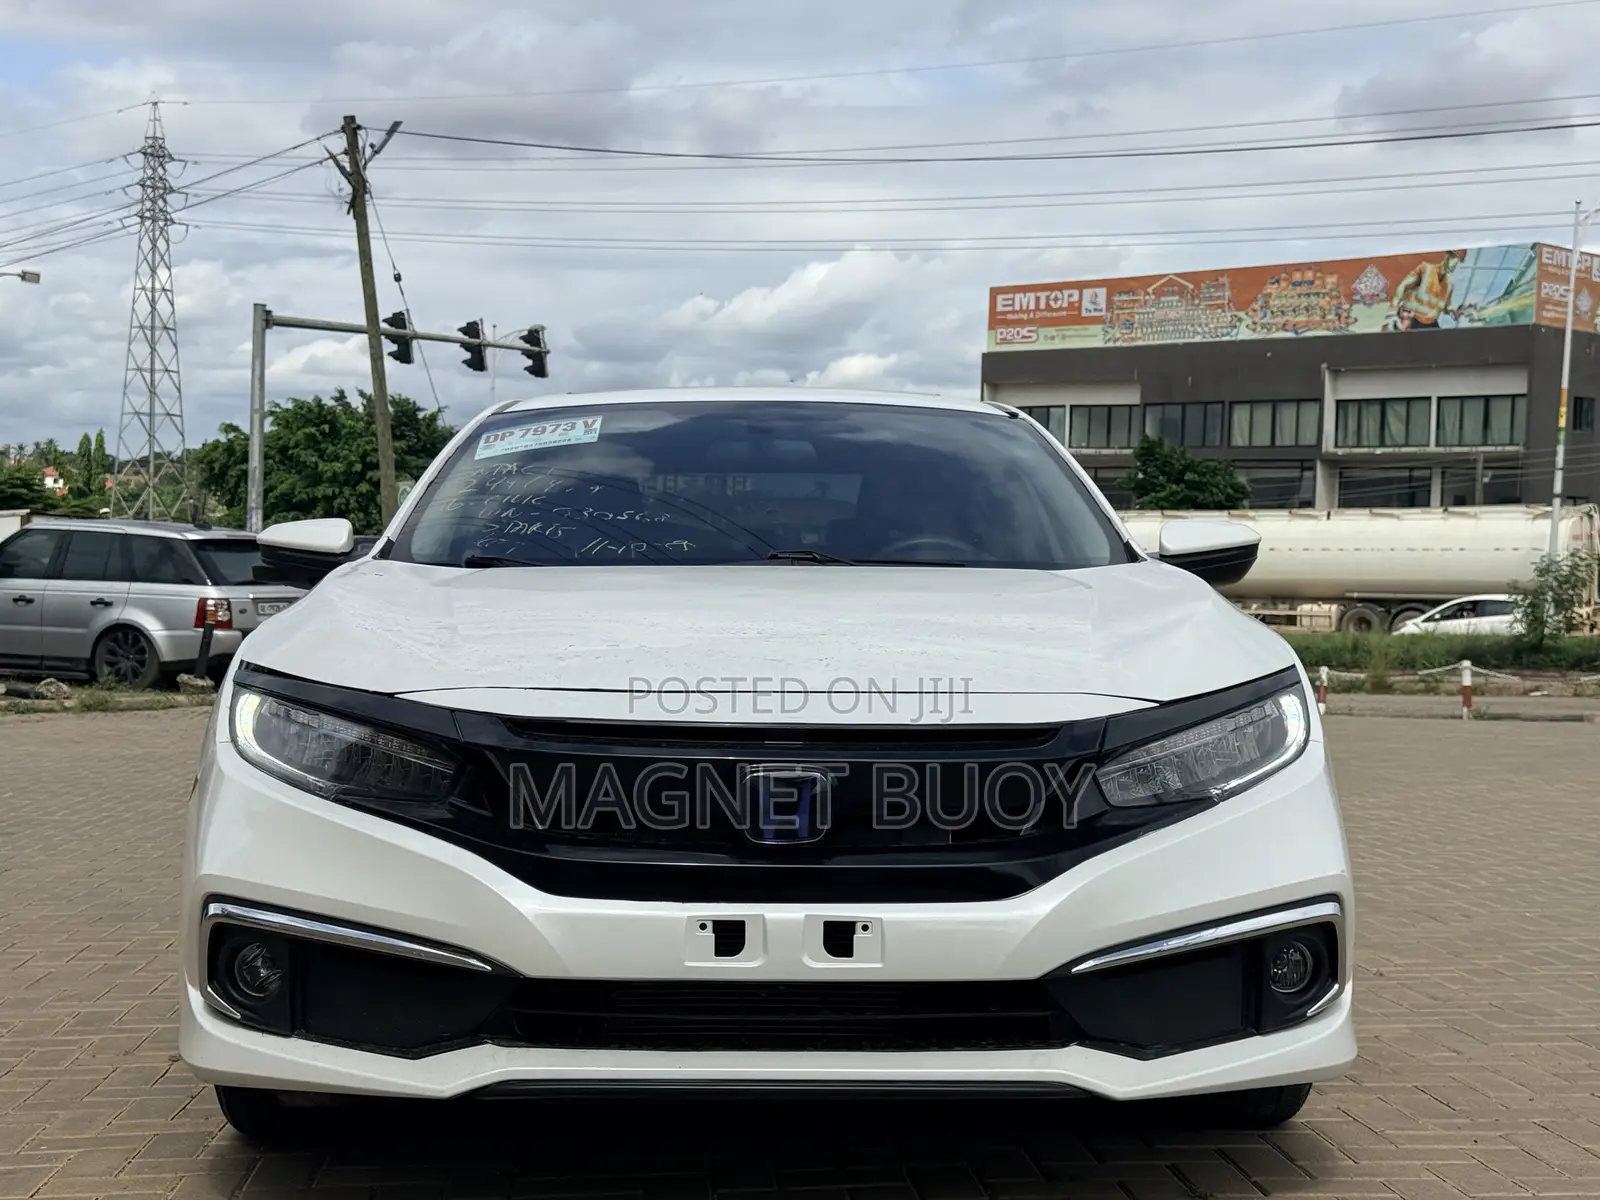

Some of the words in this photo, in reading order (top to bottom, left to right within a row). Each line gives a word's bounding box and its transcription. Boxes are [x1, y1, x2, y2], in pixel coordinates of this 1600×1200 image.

[996, 289, 1079, 312] EMTOP
[483, 430, 515, 445] DP
[519, 421, 578, 439] 7973
[583, 419, 598, 429] V
